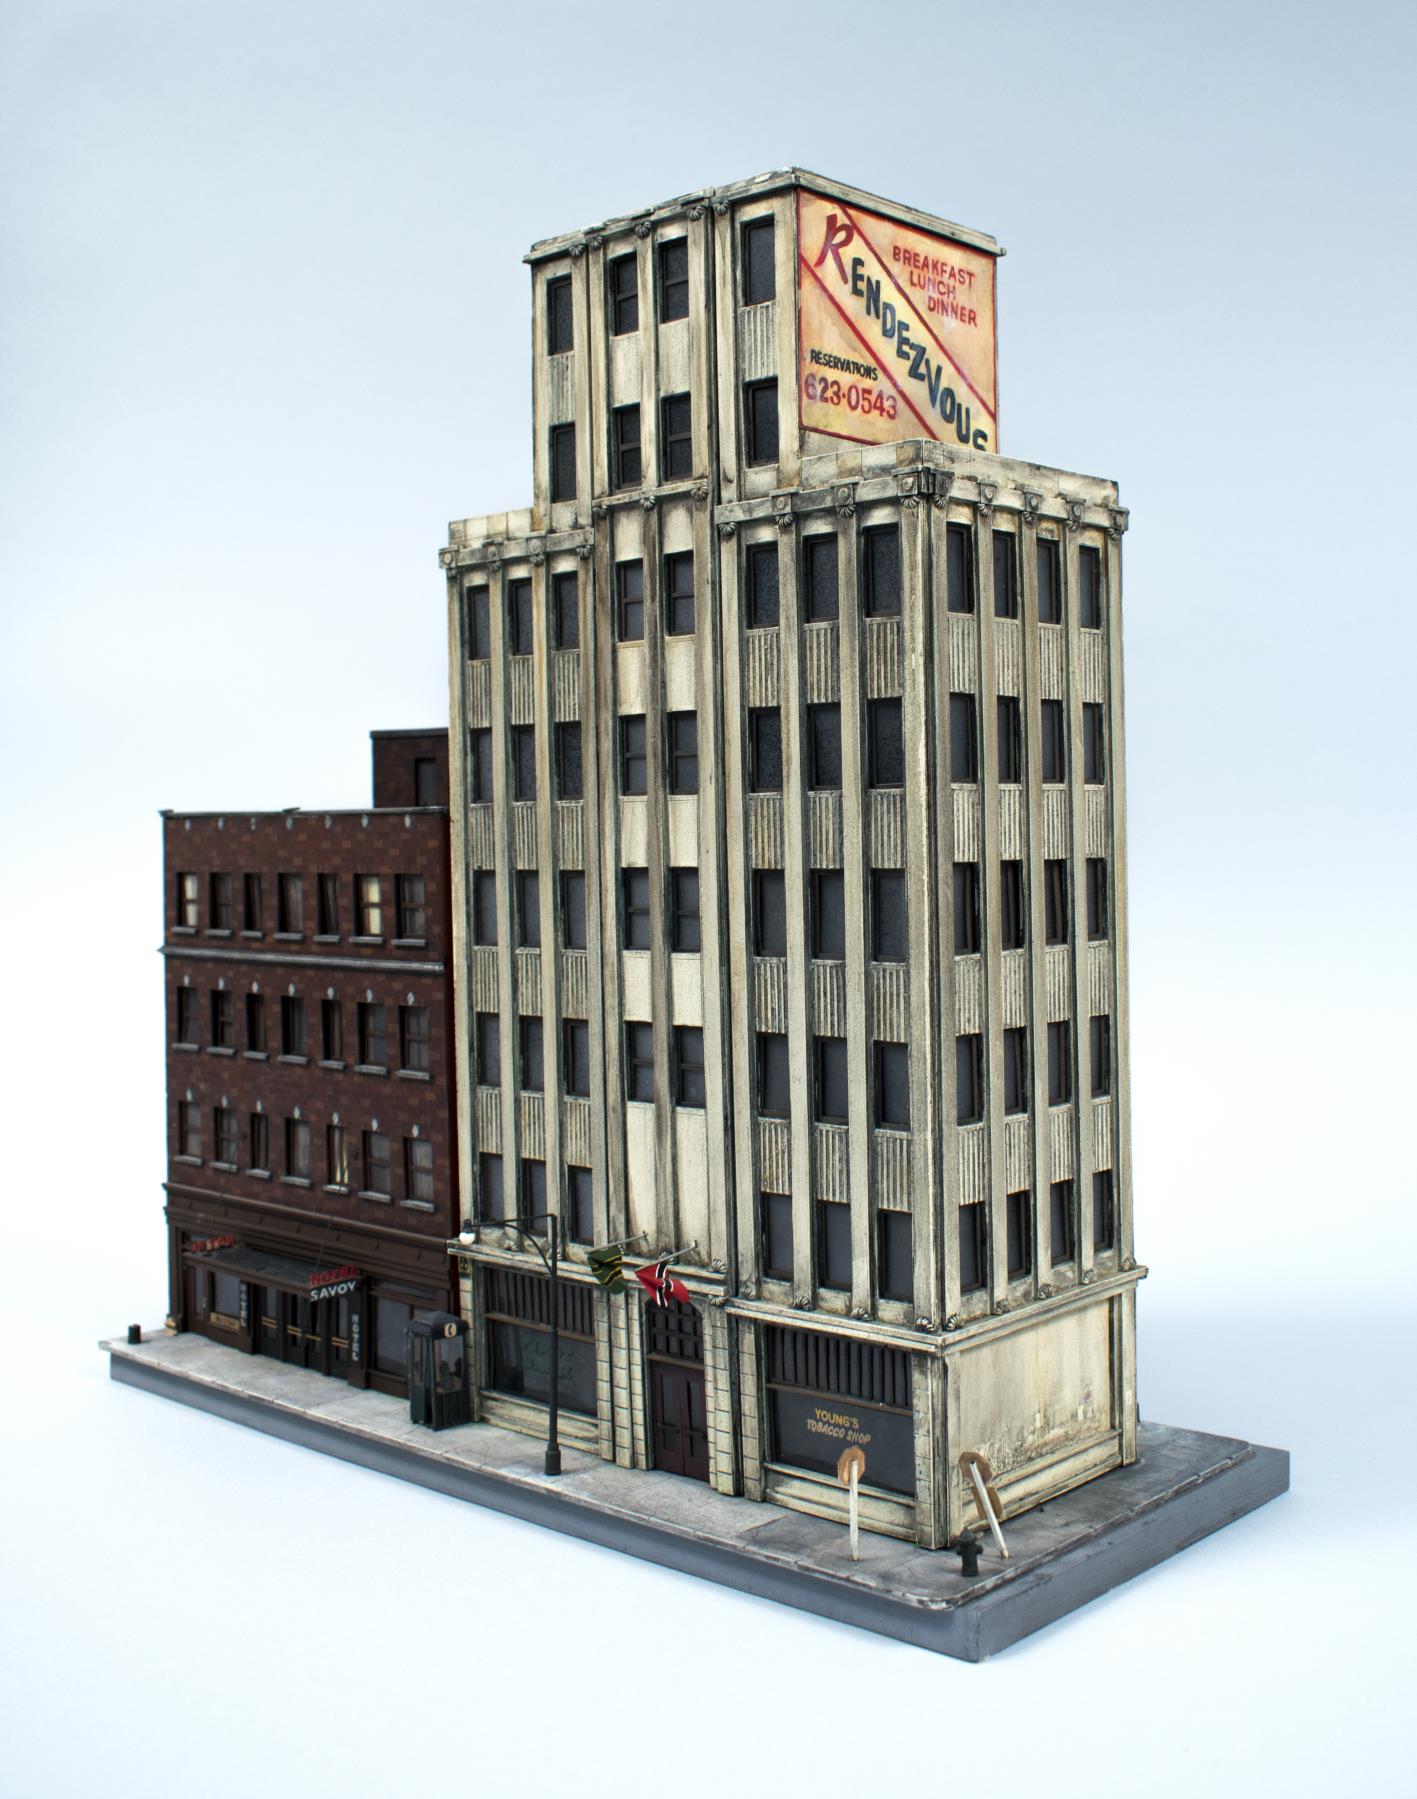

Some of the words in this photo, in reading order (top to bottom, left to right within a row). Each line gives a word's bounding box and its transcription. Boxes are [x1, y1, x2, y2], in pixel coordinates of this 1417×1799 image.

[893, 245, 975, 289] BREAKFAST
[910, 270, 956, 300] LUNCH
[928, 295, 977, 328] DINNER
[810, 349, 878, 381] RESERVATIONS
[310, 1280, 356, 1302] SAVOY
[351, 1313, 359, 1361] HOTEL
[807, 1419, 845, 1439] TOBACCO
[847, 1430, 872, 1445] SHOP
[815, 1408, 859, 1429] YOUNG'S
